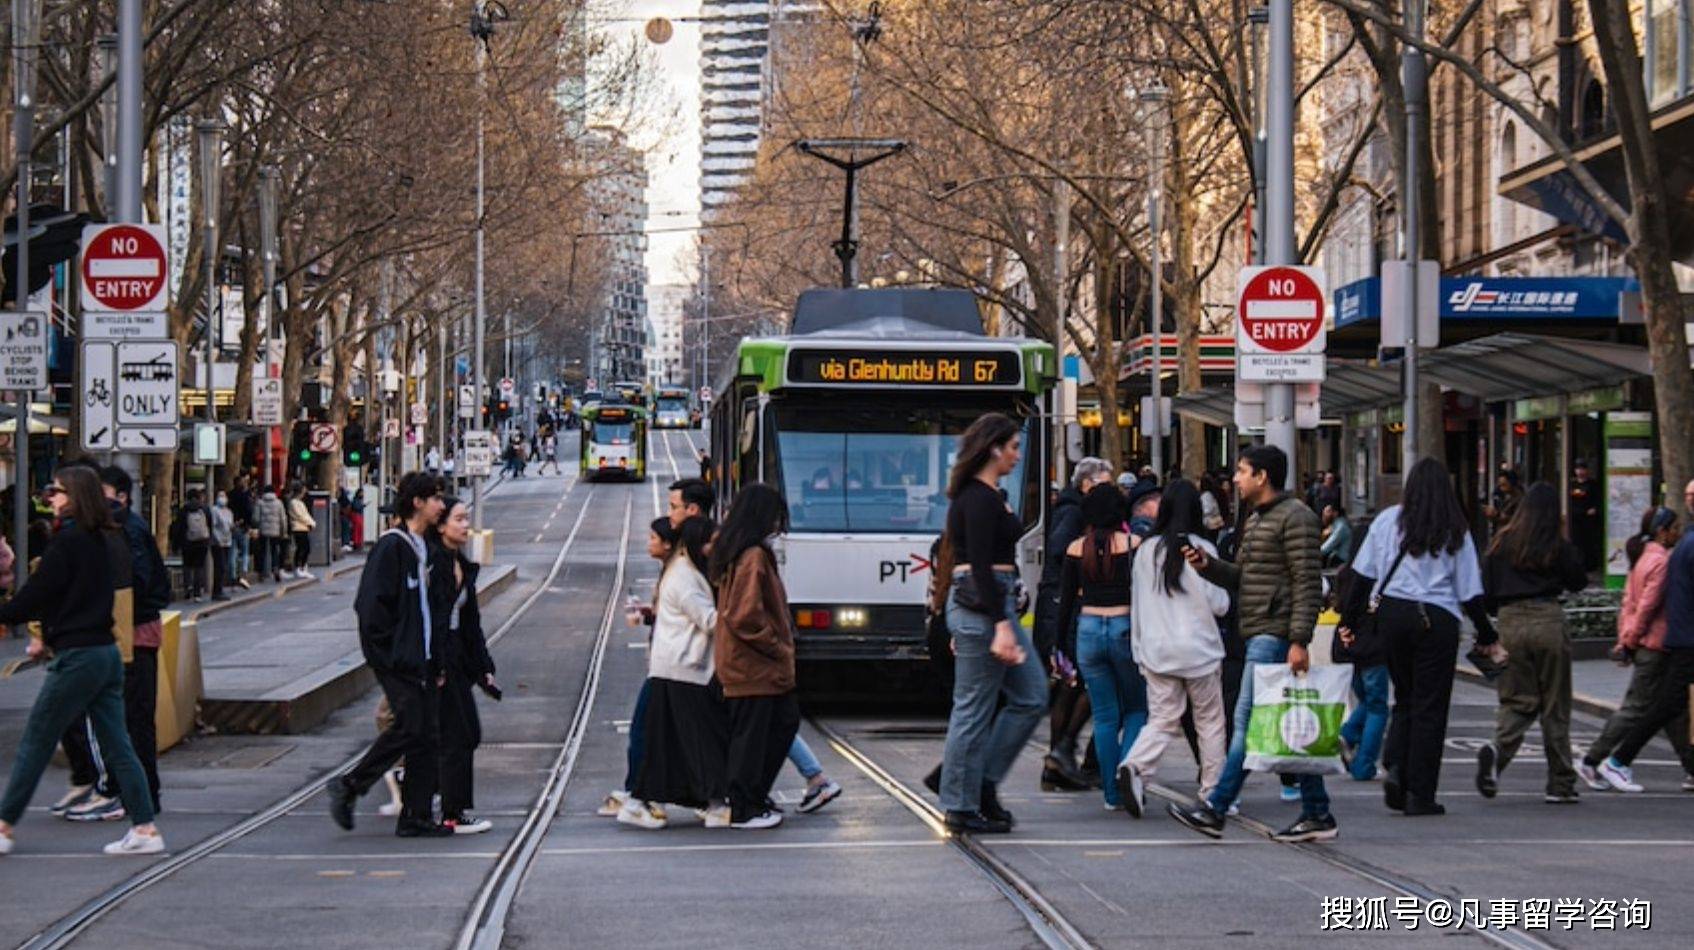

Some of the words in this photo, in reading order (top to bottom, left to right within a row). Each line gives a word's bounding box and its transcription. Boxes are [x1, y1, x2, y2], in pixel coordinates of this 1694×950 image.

[111, 237, 138, 255] NO
[95, 281, 154, 298] ENTRY
[1268, 279, 1296, 296] NO
[1252, 322, 1312, 340] ENTRY
[10, 356, 33, 365] STOP
[820, 358, 846, 380] via
[850, 358, 934, 381] Glenhuntly
[938, 360, 960, 382] Rd
[974, 360, 998, 382] 67
[7, 377, 37, 386] TRAMS
[123, 394, 171, 414] ONLY
